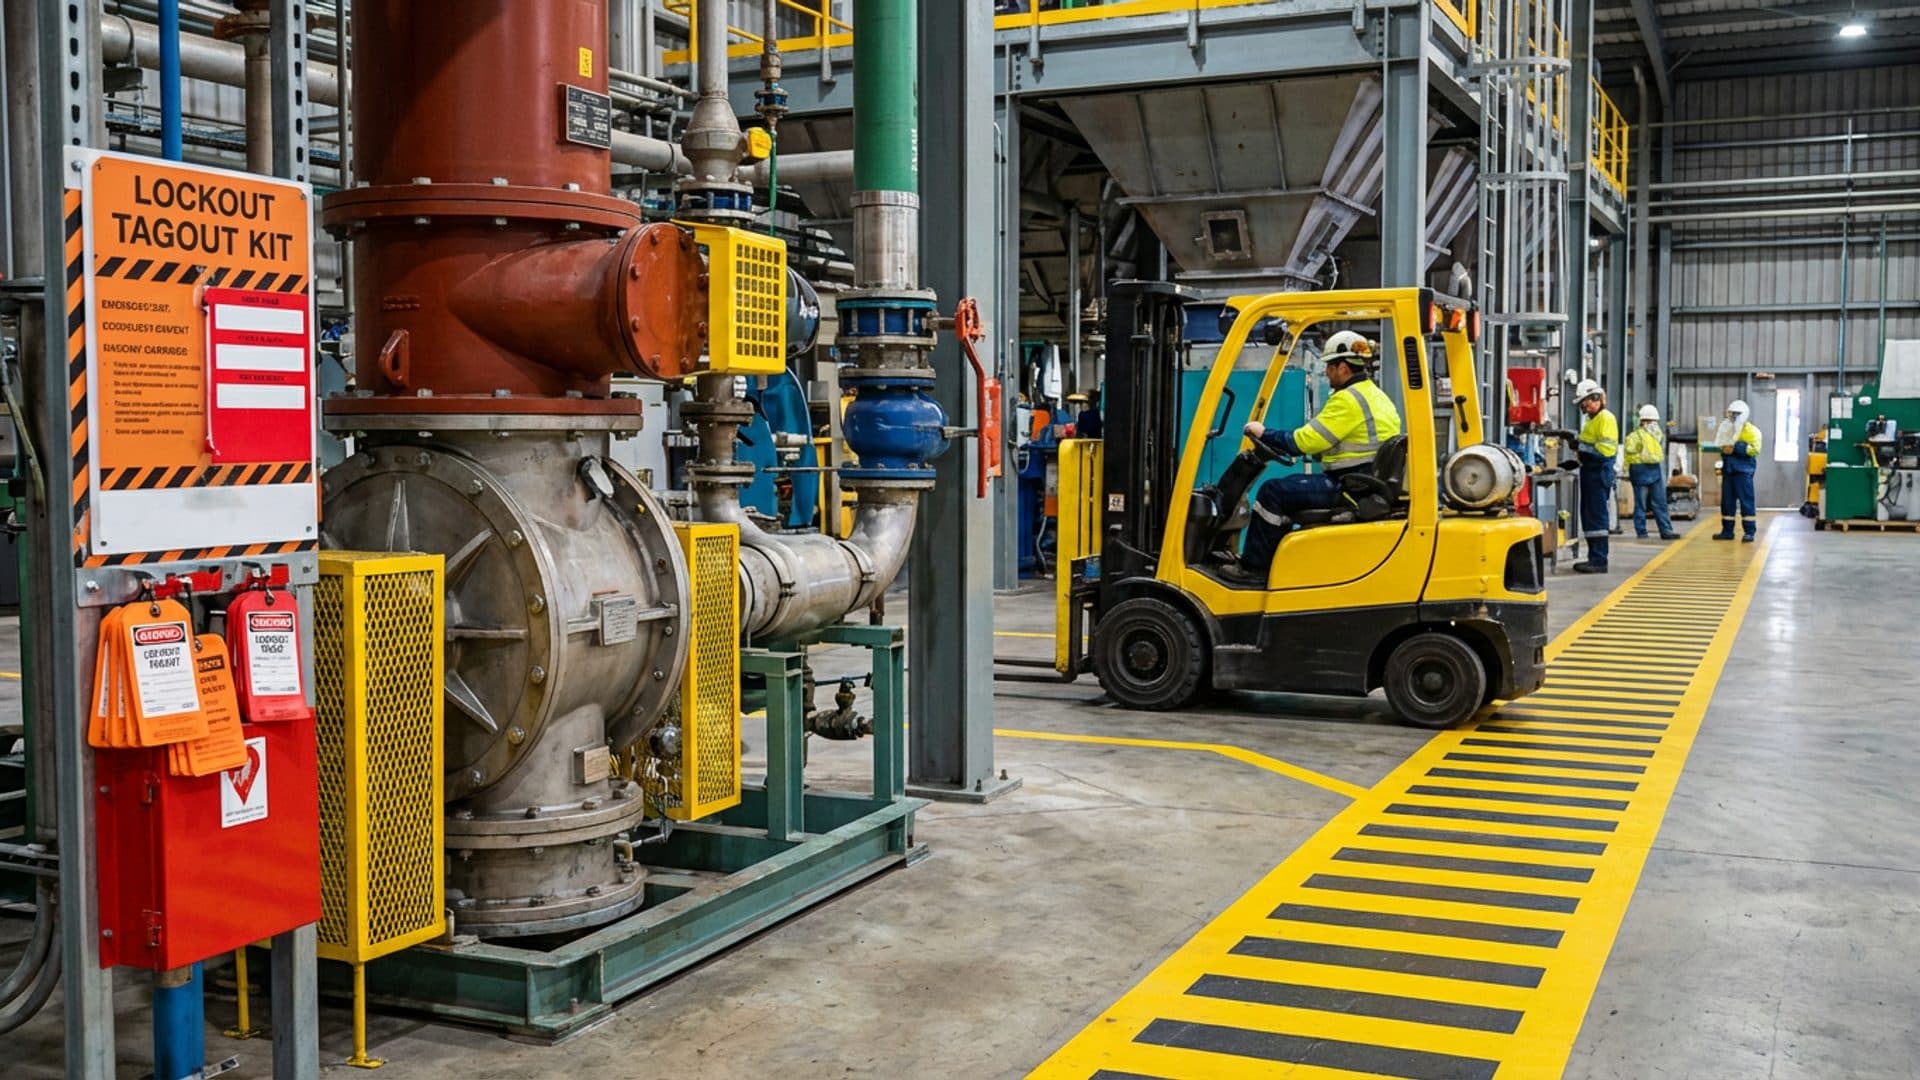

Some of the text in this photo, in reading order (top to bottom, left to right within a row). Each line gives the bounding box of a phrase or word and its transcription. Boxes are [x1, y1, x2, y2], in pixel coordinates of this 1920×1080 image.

[135, 175, 275, 222] LOCKOUT
[112, 212, 293, 262] TAGOUT KIT
